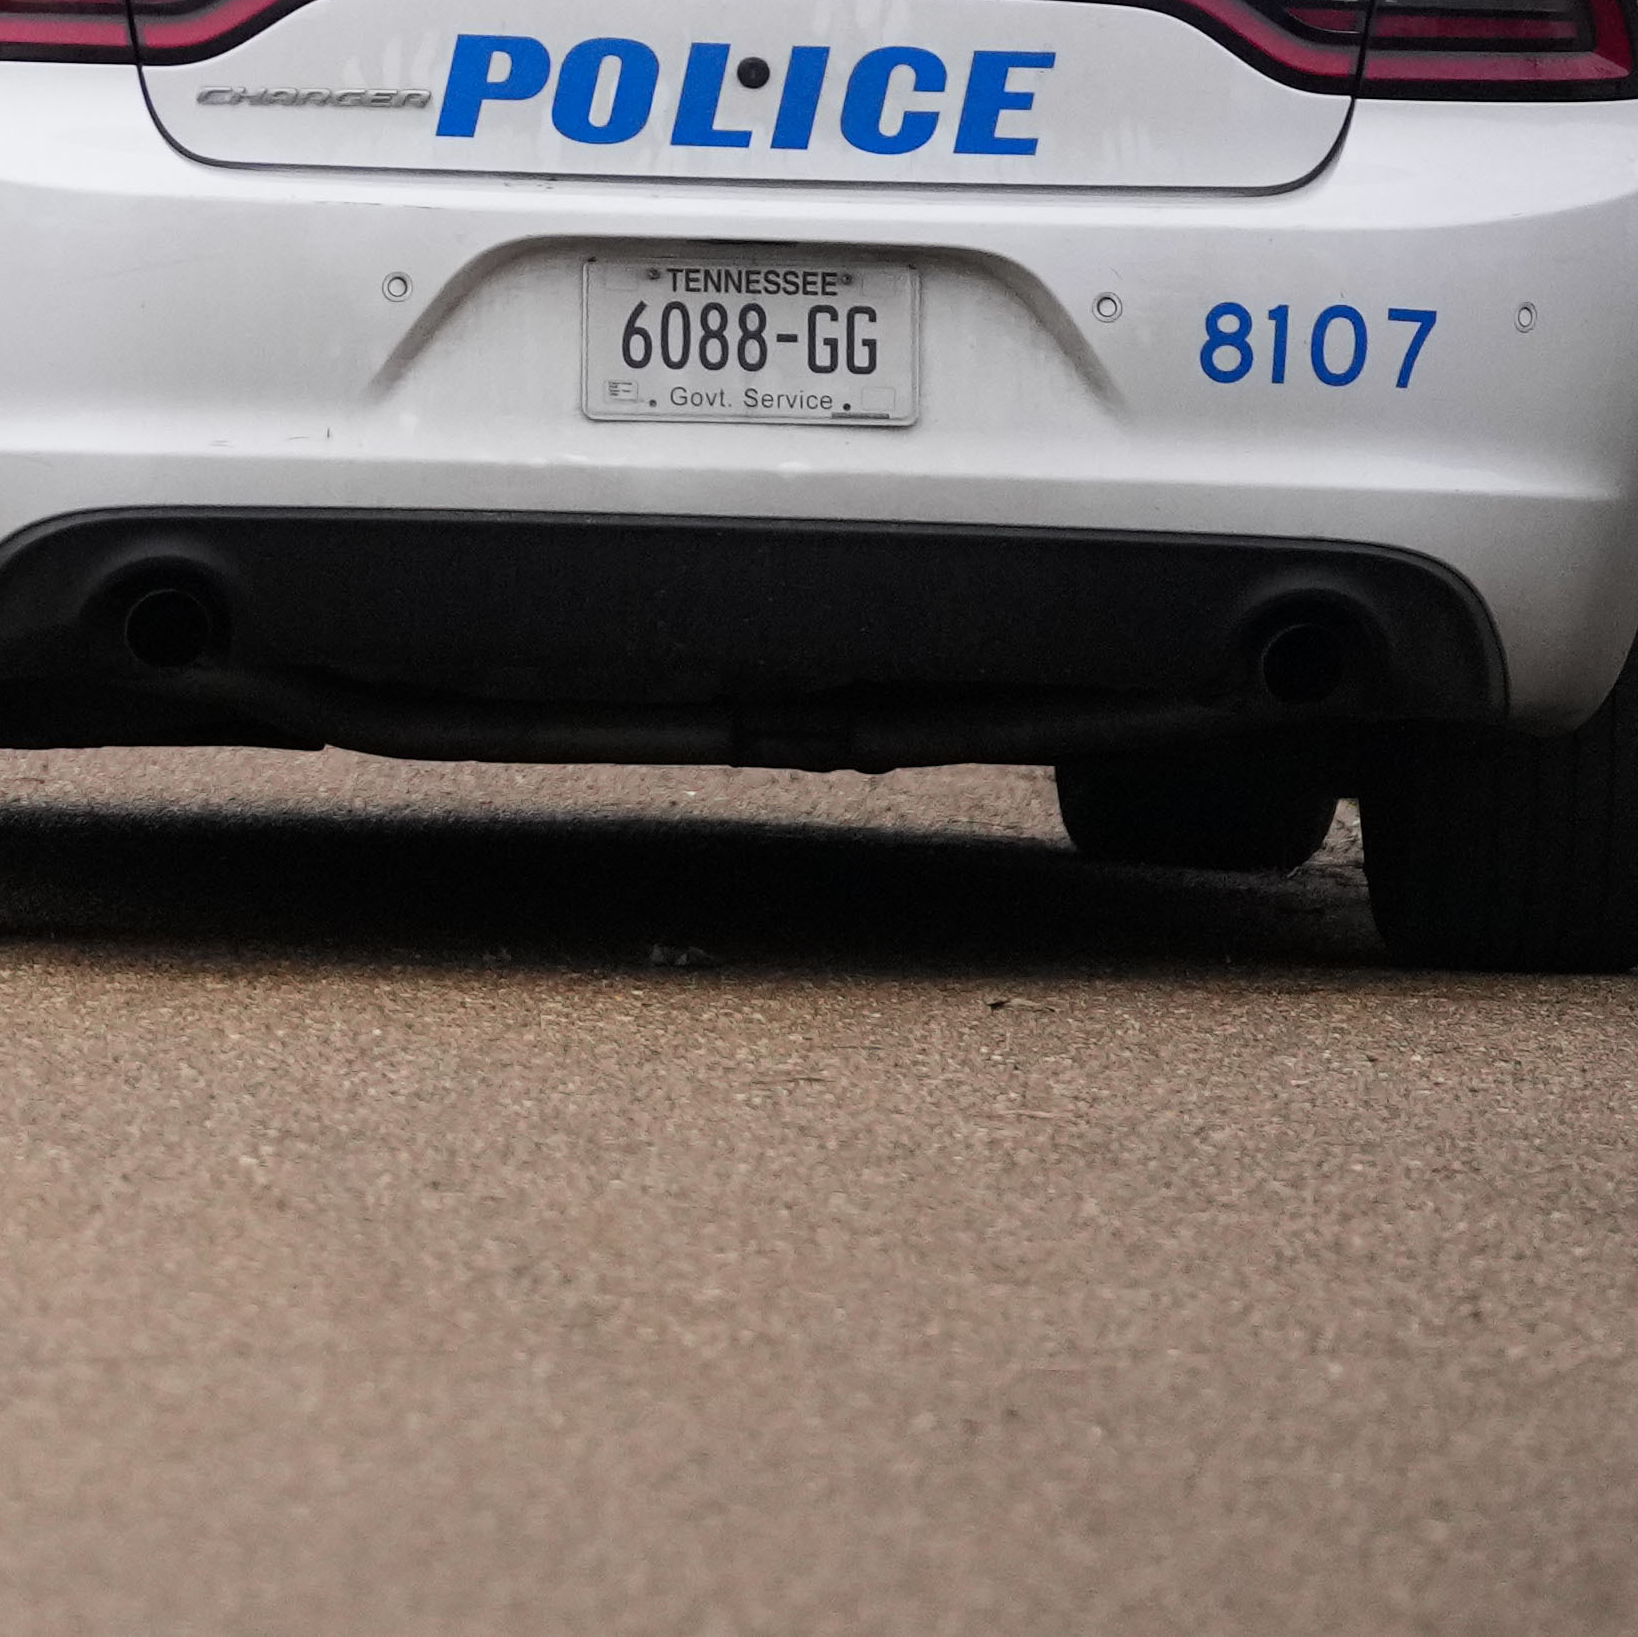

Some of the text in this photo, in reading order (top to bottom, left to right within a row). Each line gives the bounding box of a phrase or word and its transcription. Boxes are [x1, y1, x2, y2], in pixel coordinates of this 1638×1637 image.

[196, 86, 432, 108] CHARGER
[435, 34, 1057, 156] POLICE
[667, 268, 839, 297] TENNESSEE
[621, 300, 878, 376] 6088-GG
[1199, 301, 1438, 389] 8107
[669, 386, 834, 411] Govt. Service
